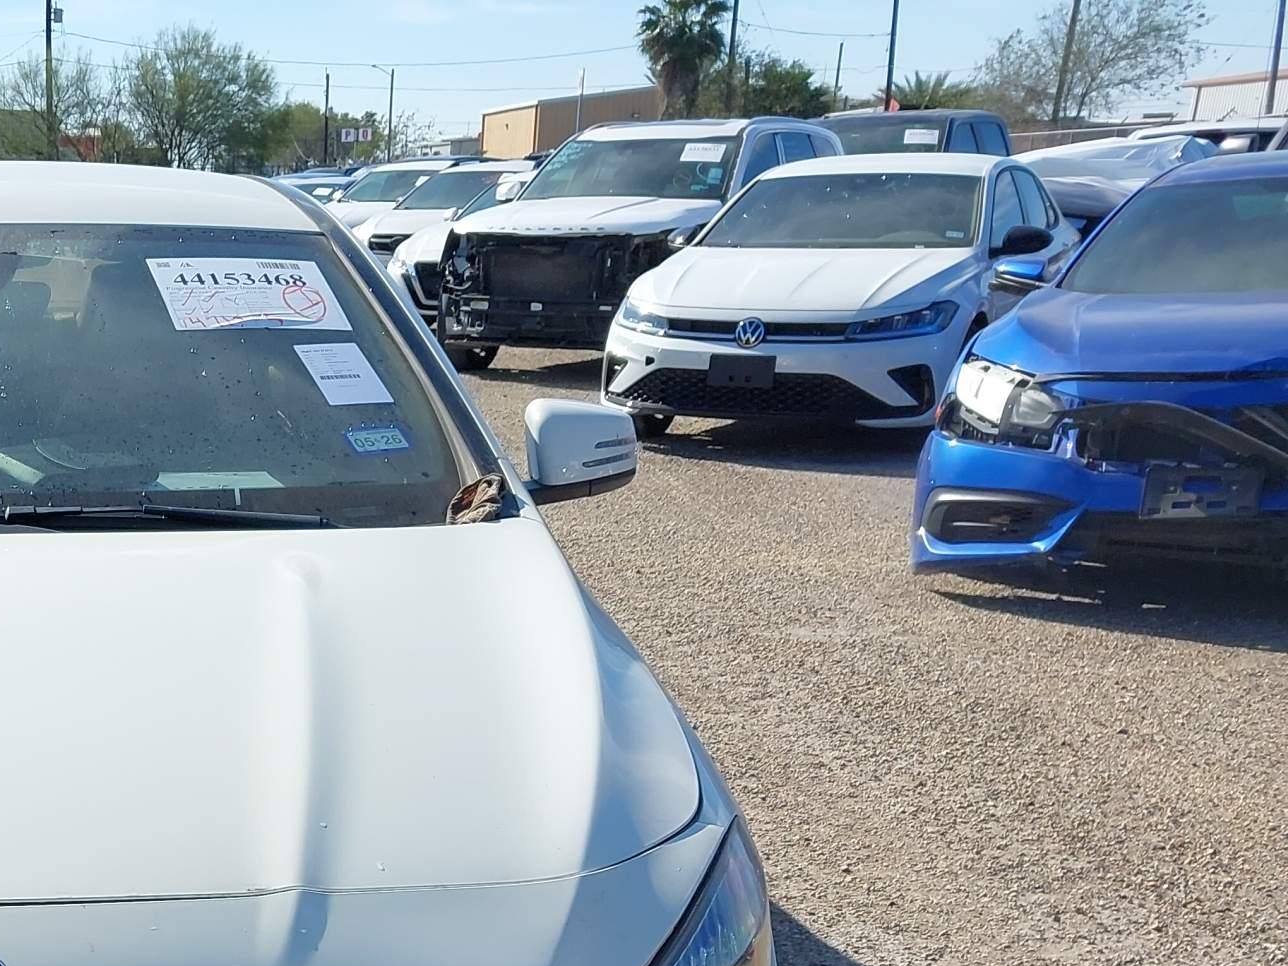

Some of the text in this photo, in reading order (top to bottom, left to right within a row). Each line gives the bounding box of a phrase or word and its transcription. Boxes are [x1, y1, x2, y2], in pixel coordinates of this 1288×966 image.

[174, 273, 307, 287] 44153468
[354, 434, 402, 448] 05 26
